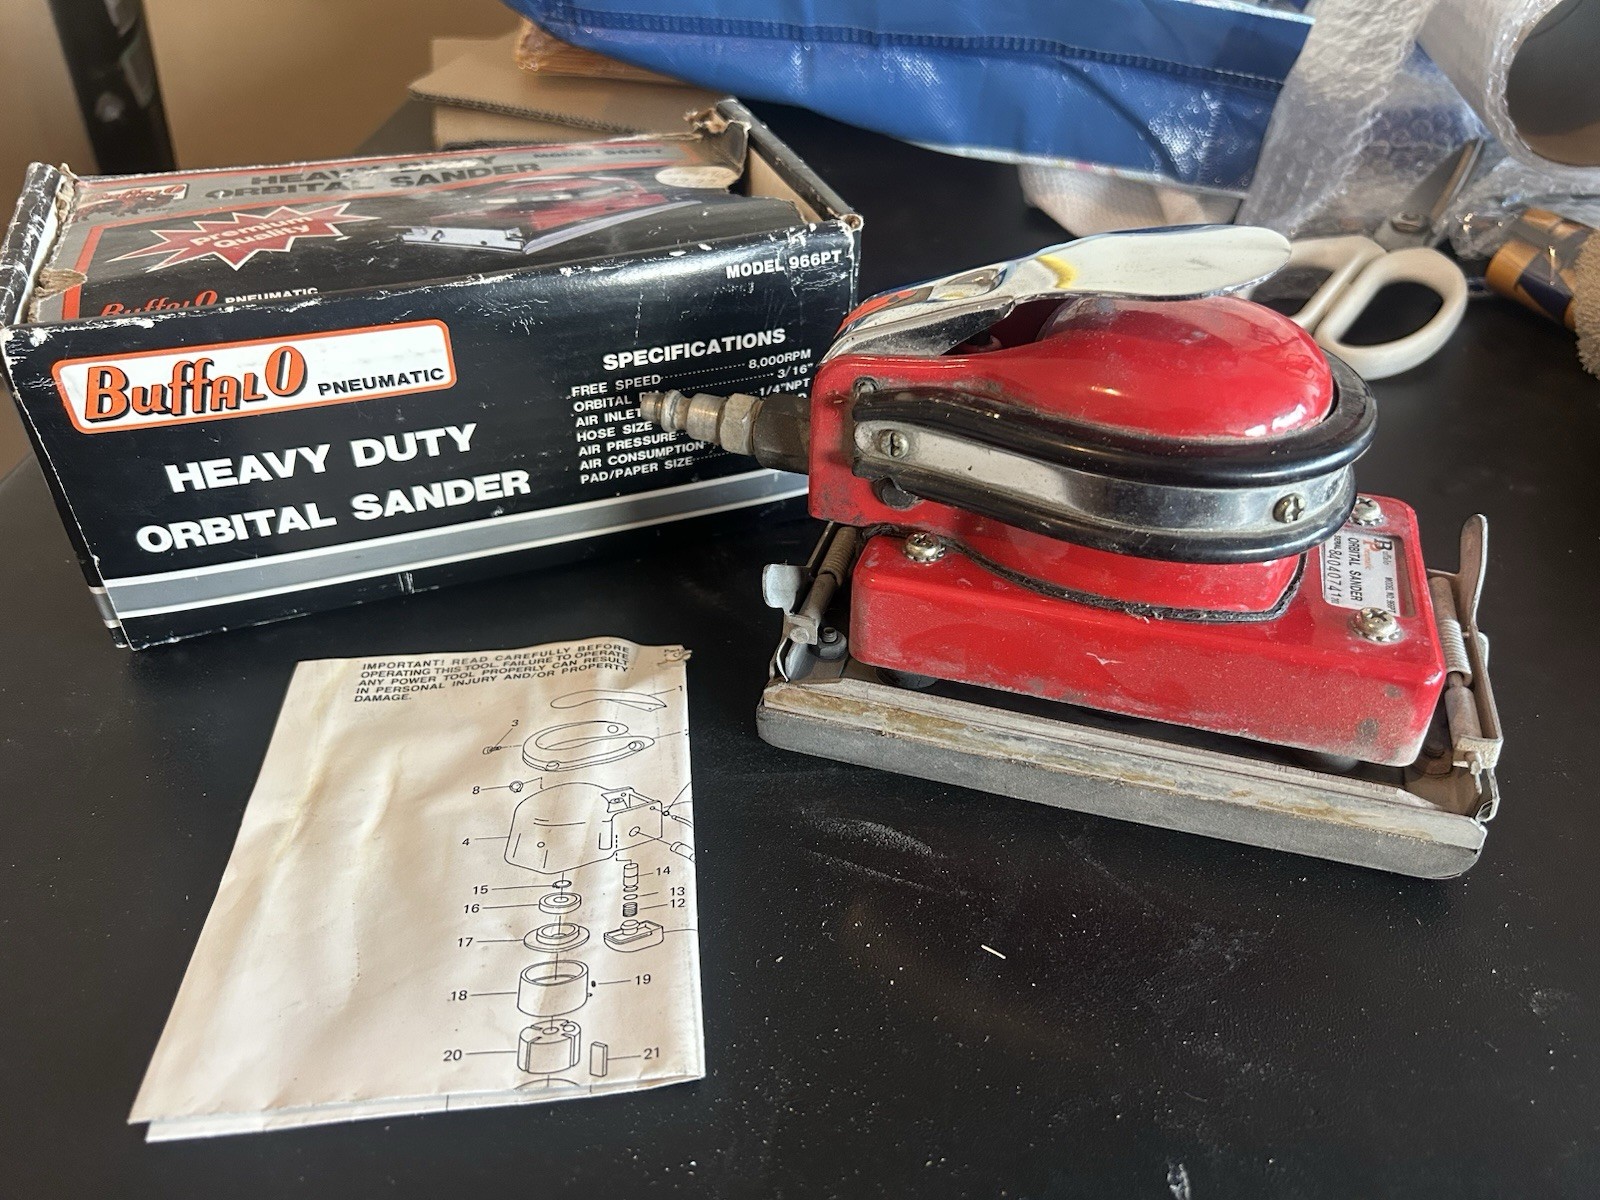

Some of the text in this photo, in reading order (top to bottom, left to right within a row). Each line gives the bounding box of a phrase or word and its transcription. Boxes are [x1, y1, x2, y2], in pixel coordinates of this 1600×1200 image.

[389, 163, 541, 188] SANDER
[213, 224, 310, 248] Quality
[725, 249, 842, 279] MODEL 966PT
[603, 328, 786, 371] SPECIFICATIONS
[317, 366, 445, 397] PNEUMATIC
[571, 348, 812, 397] FREE SPEED 8,000RPM
[573, 394, 632, 413] ORBITAL
[575, 414, 599, 428] AIR
[604, 408, 642, 423] INLET
[576, 421, 653, 442] HOSE SIZE
[578, 431, 677, 457] AIR PRESSURE
[164, 422, 477, 493] HEAVY DUTY
[580, 458, 602, 471] AIR
[608, 441, 705, 466] CONSUMPTION
[580, 456, 694, 485] PAD/PAPER SIZE
[136, 469, 531, 554] ORBITAL SANDER
[1348, 537, 1363, 602] ORBITAL SANDER
[360, 668, 431, 679] OPERATING
[434, 666, 461, 675] THIS
[503, 656, 553, 667] FAILURE
[574, 650, 629, 660] OPERATE
[362, 643, 630, 671] IMPORTANT! READ CAREFULLY BEFORE
[356, 663, 629, 695] IN PERSONAL INJURY AND/OR PROPERTY
[358, 656, 629, 687] ANY POWER TOOL PROPERLY CAN RESULT
[354, 693, 412, 703] DAMAGE.
[511, 719, 519, 727] 3
[472, 786, 480, 795] 8
[462, 837, 470, 846] 4
[655, 866, 671, 876] 14
[472, 885, 489, 895] 15
[669, 886, 686, 896] 13
[463, 904, 480, 914] 16
[670, 898, 686, 908] 12
[457, 937, 473, 947] 17
[635, 974, 651, 985] 19
[450, 990, 468, 1001] 18
[443, 1050, 462, 1061] 20
[643, 1047, 660, 1059] 21
